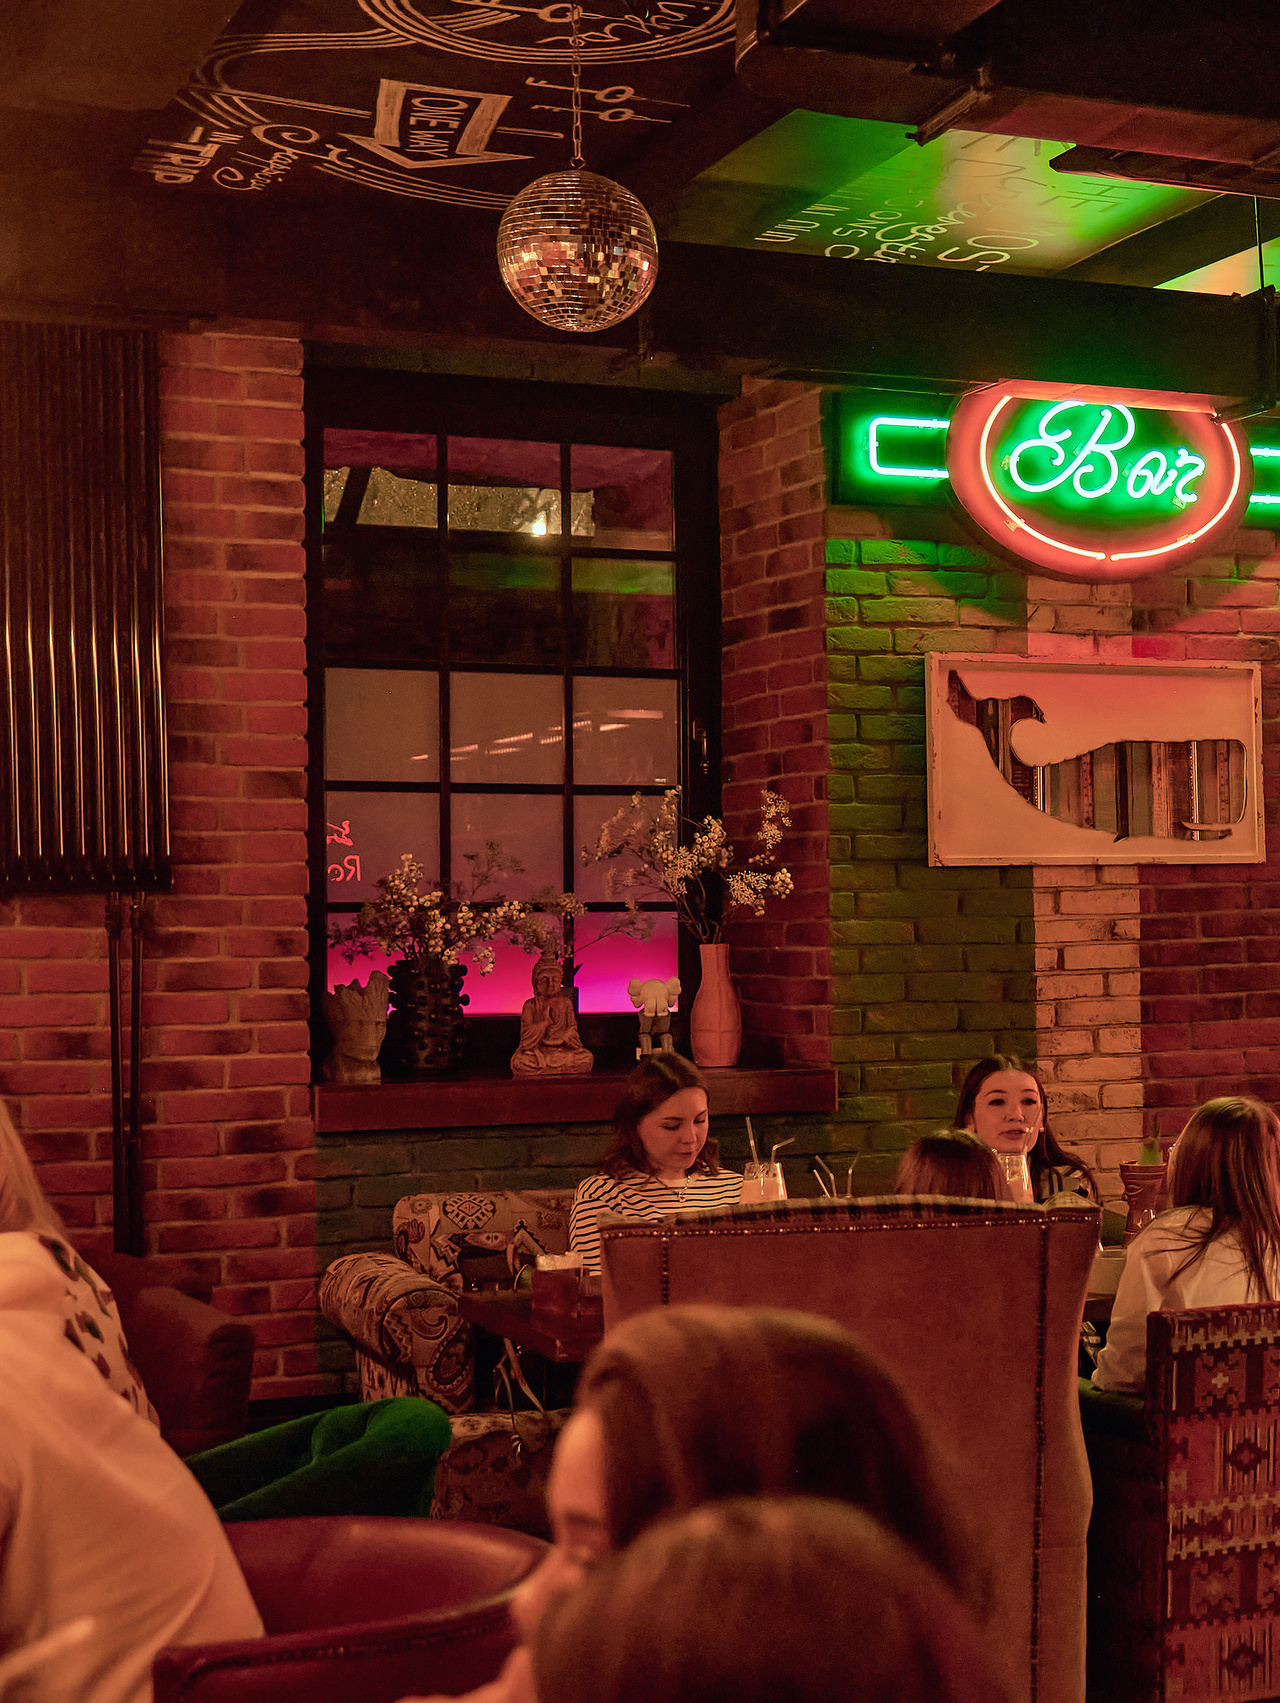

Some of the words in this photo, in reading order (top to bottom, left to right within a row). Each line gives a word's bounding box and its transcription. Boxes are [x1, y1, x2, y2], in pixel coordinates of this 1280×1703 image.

[408, 97, 469, 128] ONE
[405, 130, 455, 158] WAY
[1038, 181, 1148, 213] HE
[1009, 400, 1206, 503] Bar
